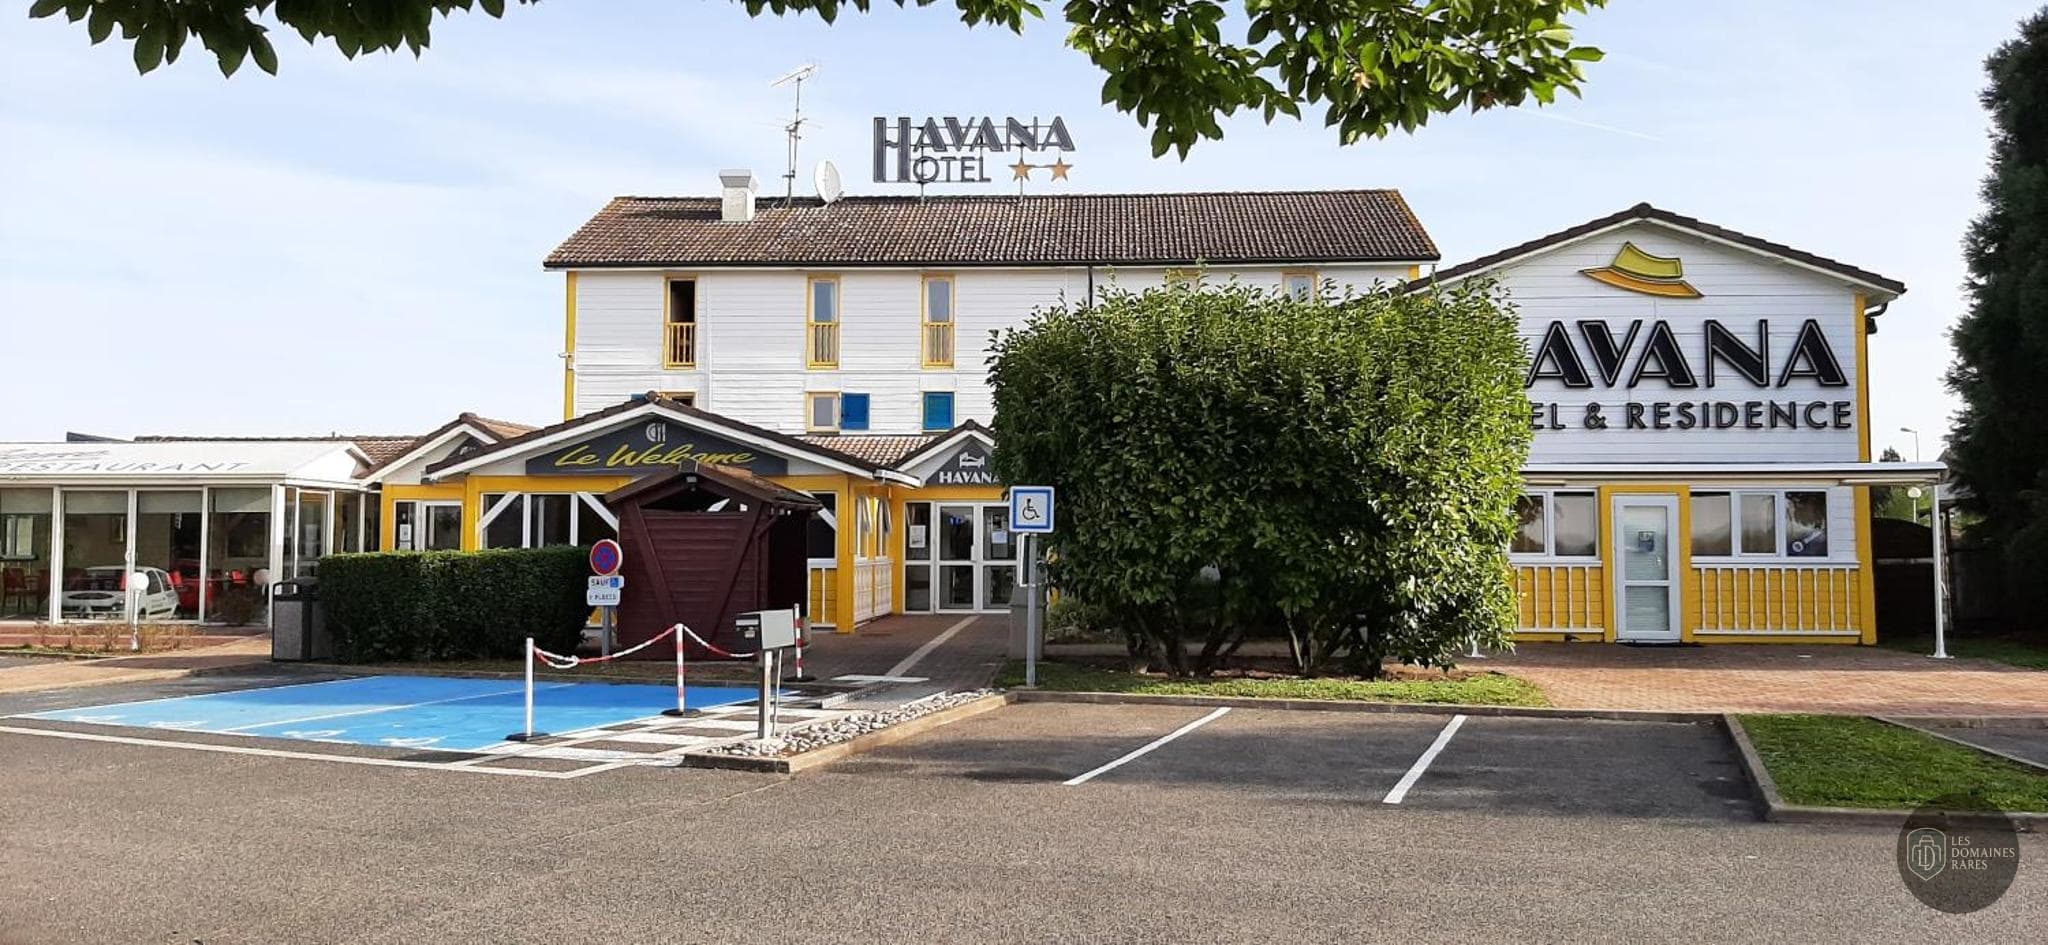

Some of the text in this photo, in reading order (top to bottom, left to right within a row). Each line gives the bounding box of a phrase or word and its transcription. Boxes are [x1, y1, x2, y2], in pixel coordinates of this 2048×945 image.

[873, 116, 1076, 183] HAVANA
[1525, 318, 1849, 389] AVANA
[1584, 401, 1608, 430] &
[1626, 400, 1852, 430] RESIDENCE
[555, 443, 757, 467] Le Welcome
